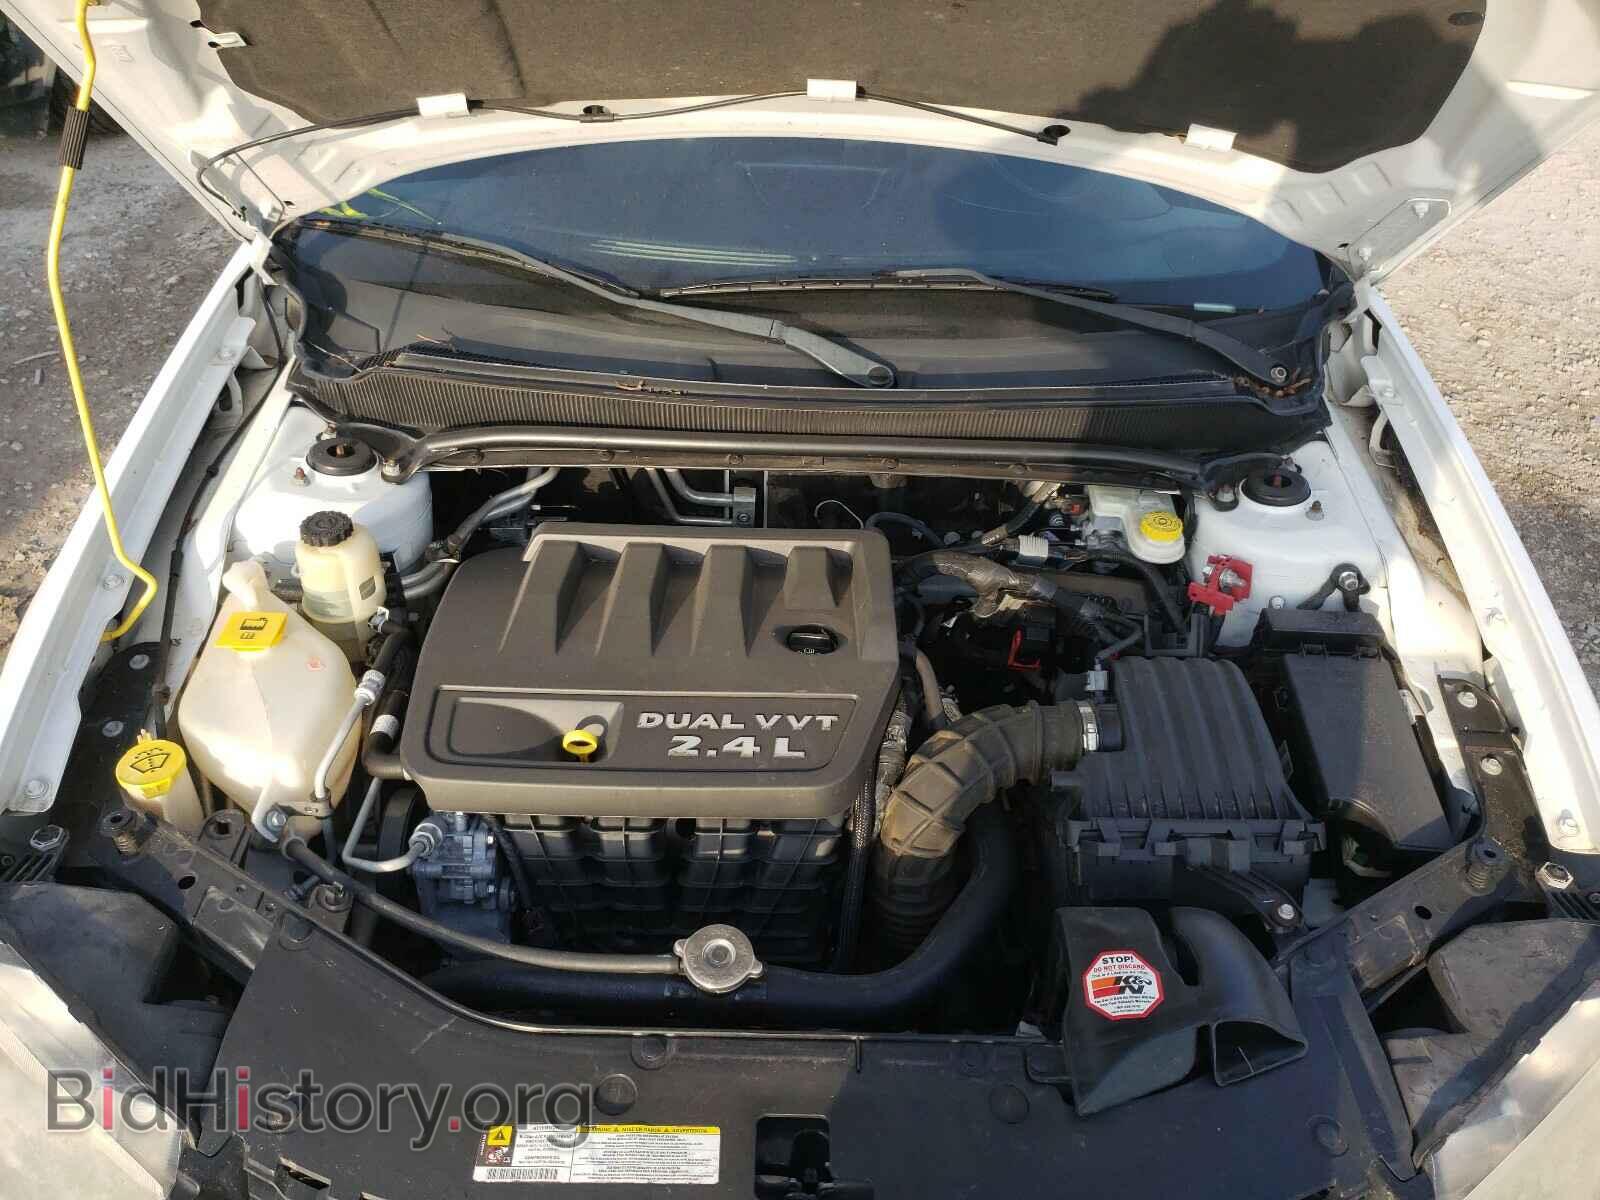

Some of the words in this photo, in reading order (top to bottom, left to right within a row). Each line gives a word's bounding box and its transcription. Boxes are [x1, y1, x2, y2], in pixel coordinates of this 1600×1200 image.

[636, 712, 745, 730] DUAL
[754, 713, 840, 731] VVT
[1102, 955, 1134, 965] STOP!
[1103, 964, 1117, 972] NOT
